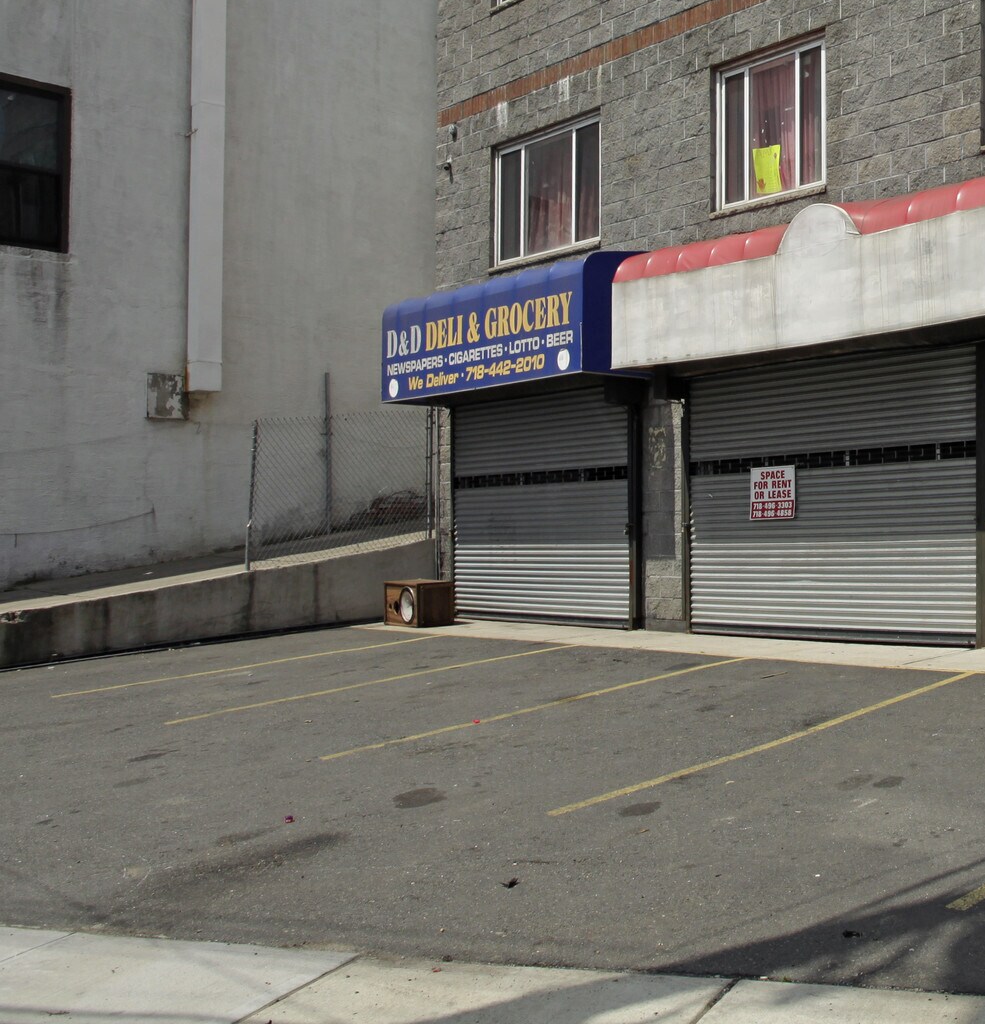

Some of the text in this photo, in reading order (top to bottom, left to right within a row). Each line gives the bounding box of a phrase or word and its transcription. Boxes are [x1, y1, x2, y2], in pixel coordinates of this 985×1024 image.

[387, 291, 573, 359] D&D DELI & GROCERY
[509, 336, 540, 354] LOTTO
[546, 330, 573, 348] BEER
[408, 353, 545, 391] We Deliver 718-442-2010
[760, 470, 785, 480] SPACE
[754, 480, 792, 490] FOR RENT
[754, 490, 791, 500] OR LEASE
